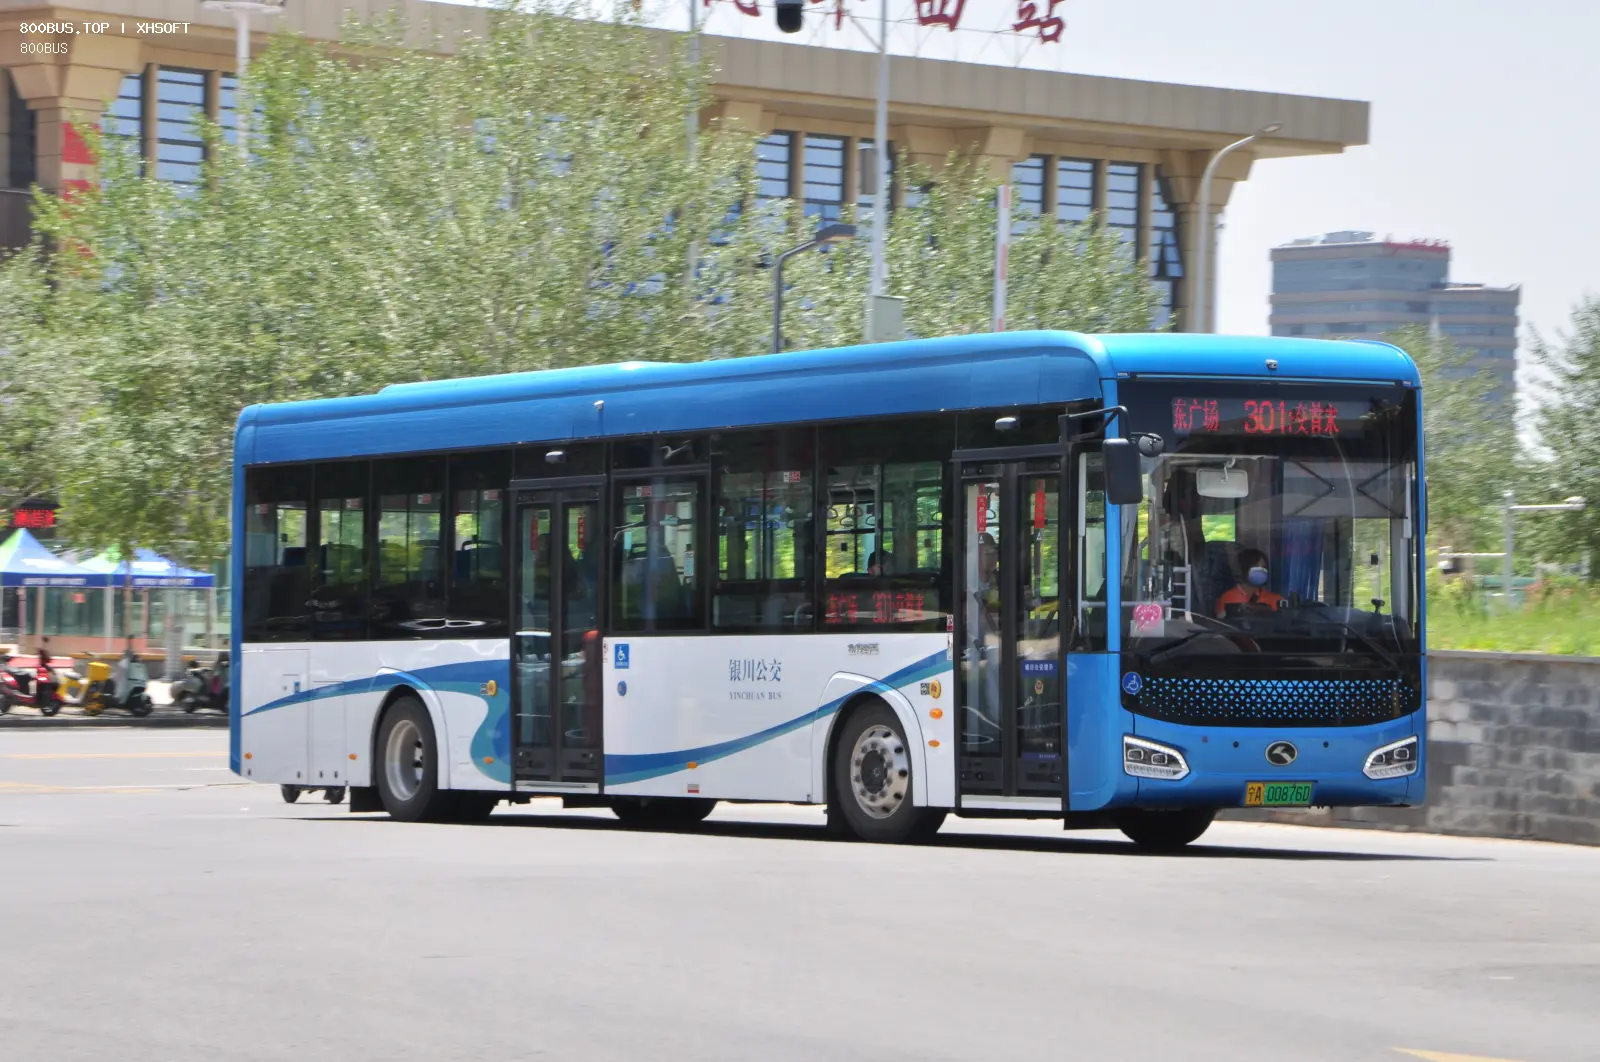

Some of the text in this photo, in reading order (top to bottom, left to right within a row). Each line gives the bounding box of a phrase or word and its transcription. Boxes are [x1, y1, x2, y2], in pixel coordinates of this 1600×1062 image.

[1172, 398, 1219, 432] 东广场
[729, 658, 782, 682] 银川公交
[729, 691, 782, 700] YINCHUAN BUS
